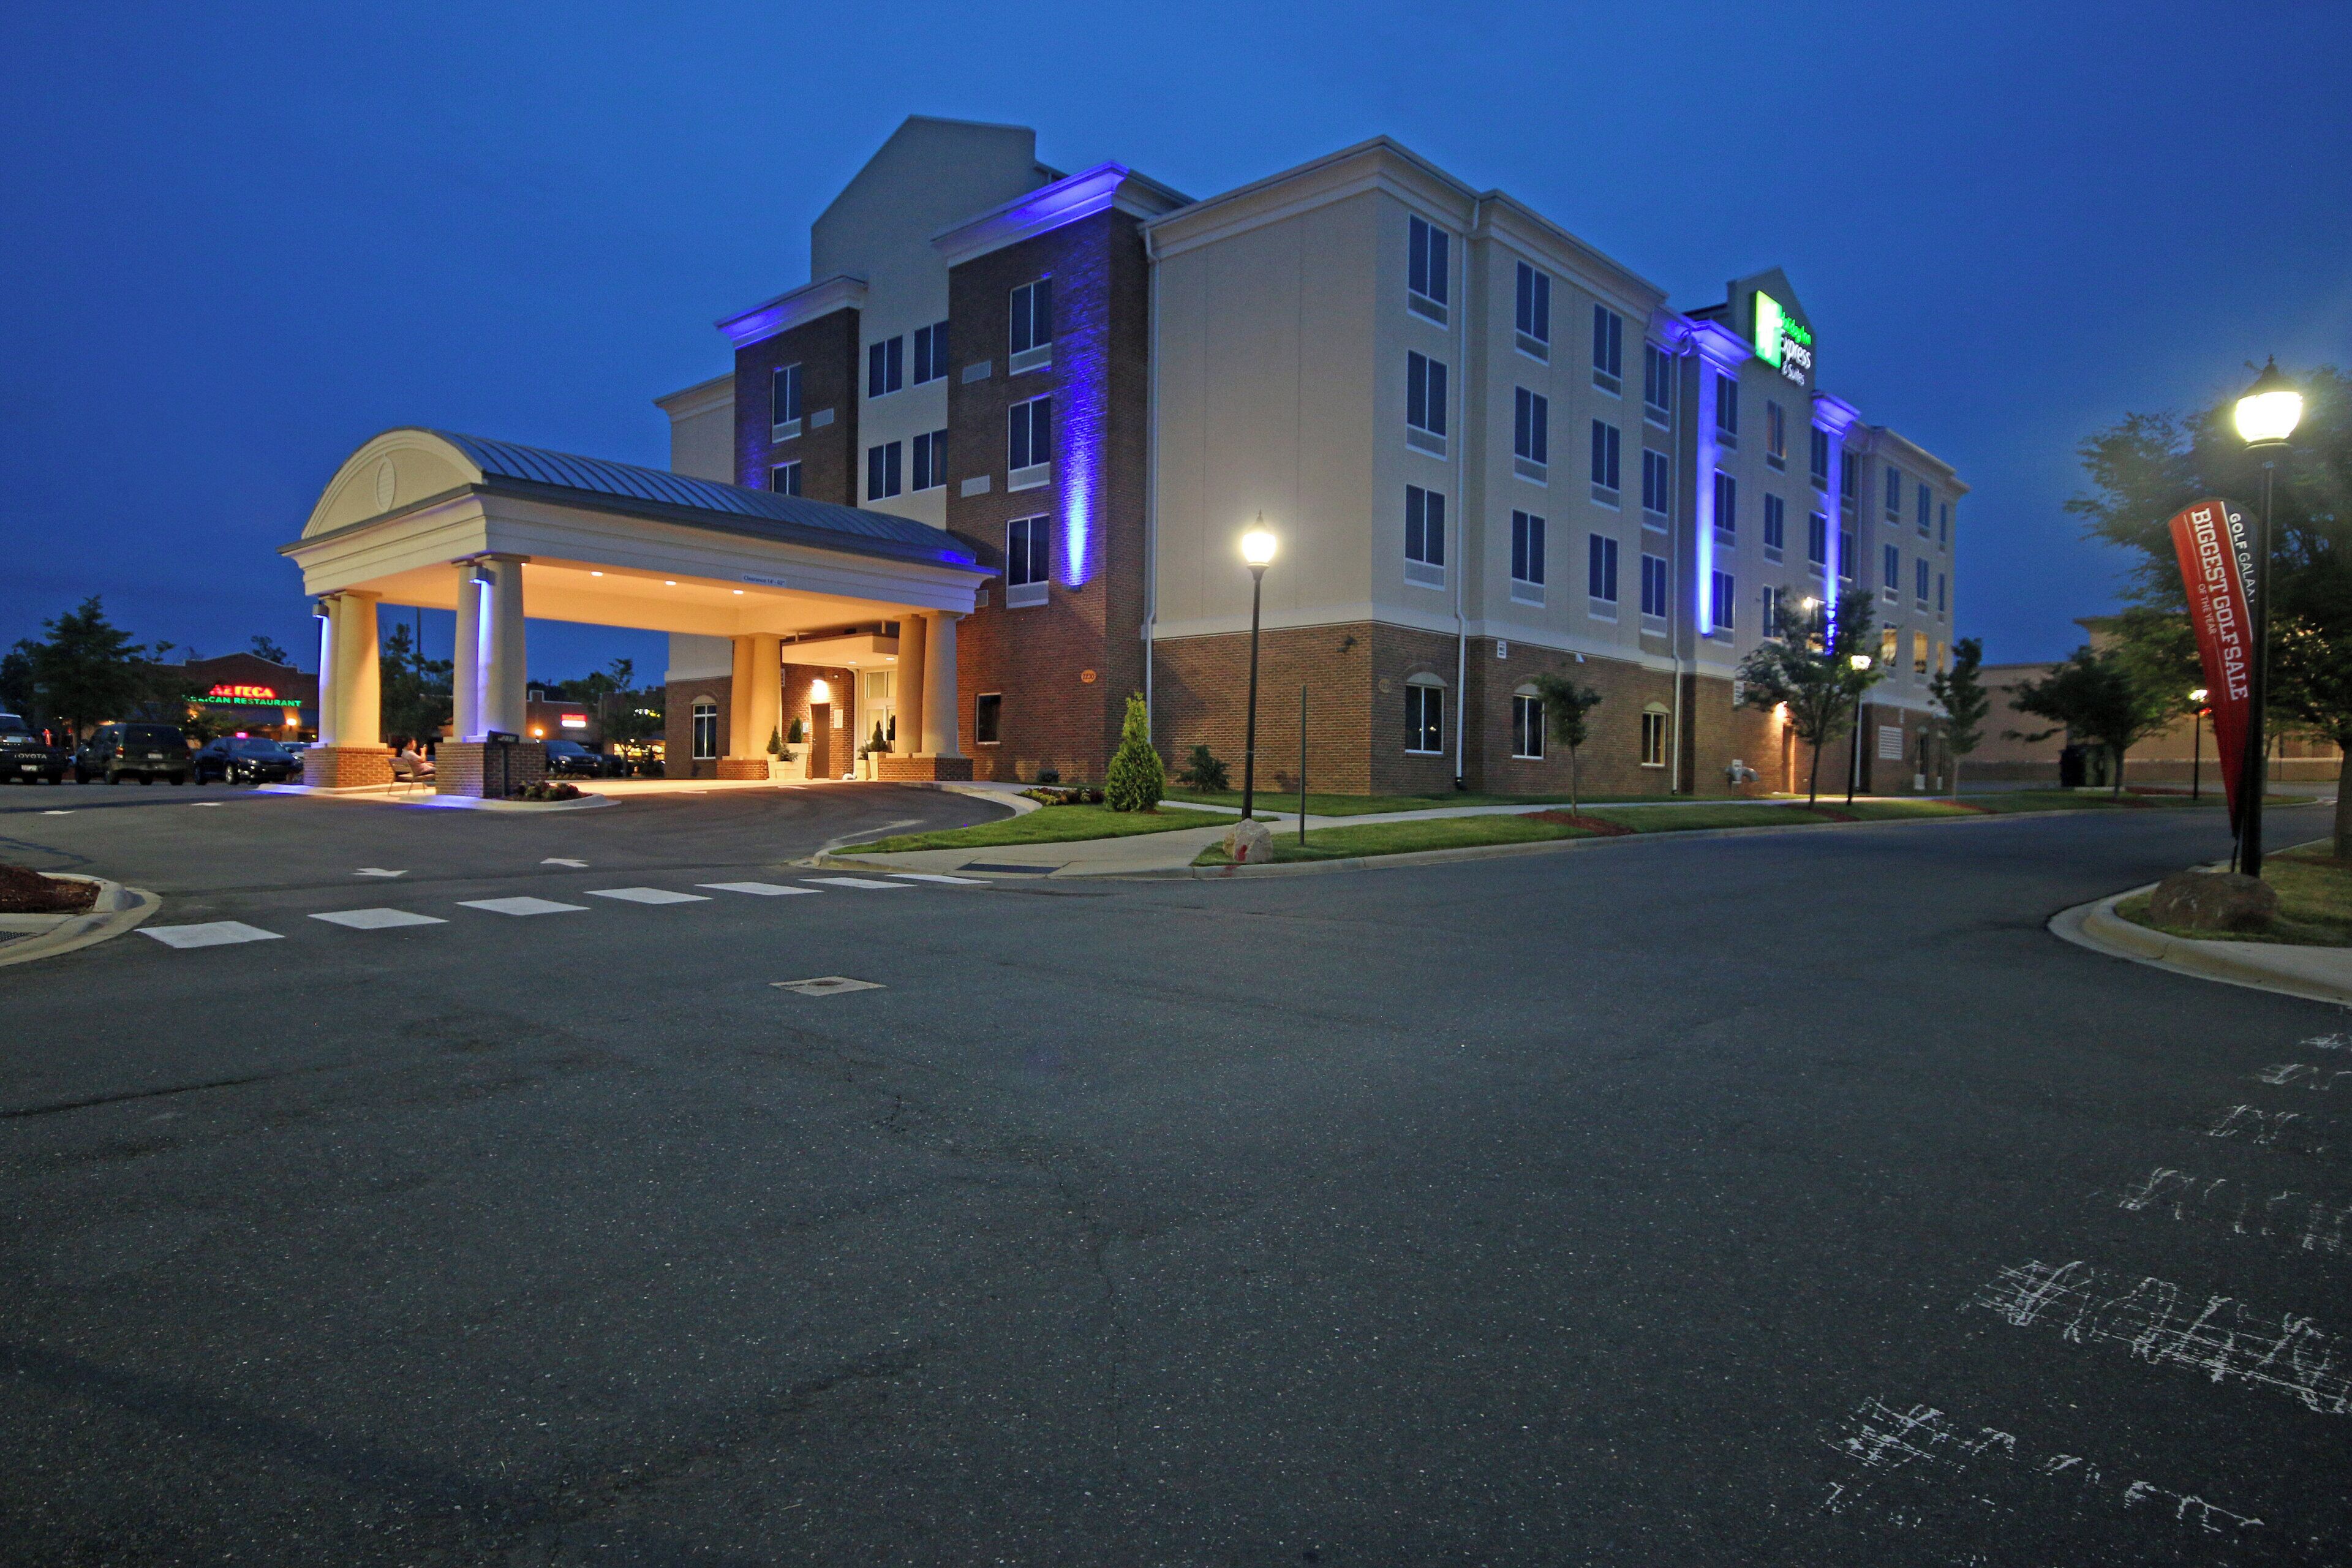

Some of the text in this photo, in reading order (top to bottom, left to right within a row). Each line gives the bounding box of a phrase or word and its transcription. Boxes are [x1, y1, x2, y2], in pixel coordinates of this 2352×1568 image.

[1787, 364, 1805, 386] Suites
[2230, 513, 2247, 550] GOLF
[2192, 508, 2248, 700] BIGGEST GOLF SALE
[2198, 583, 2217, 635] OF THE YEAR
[233, 697, 301, 707] RESTAURANT
